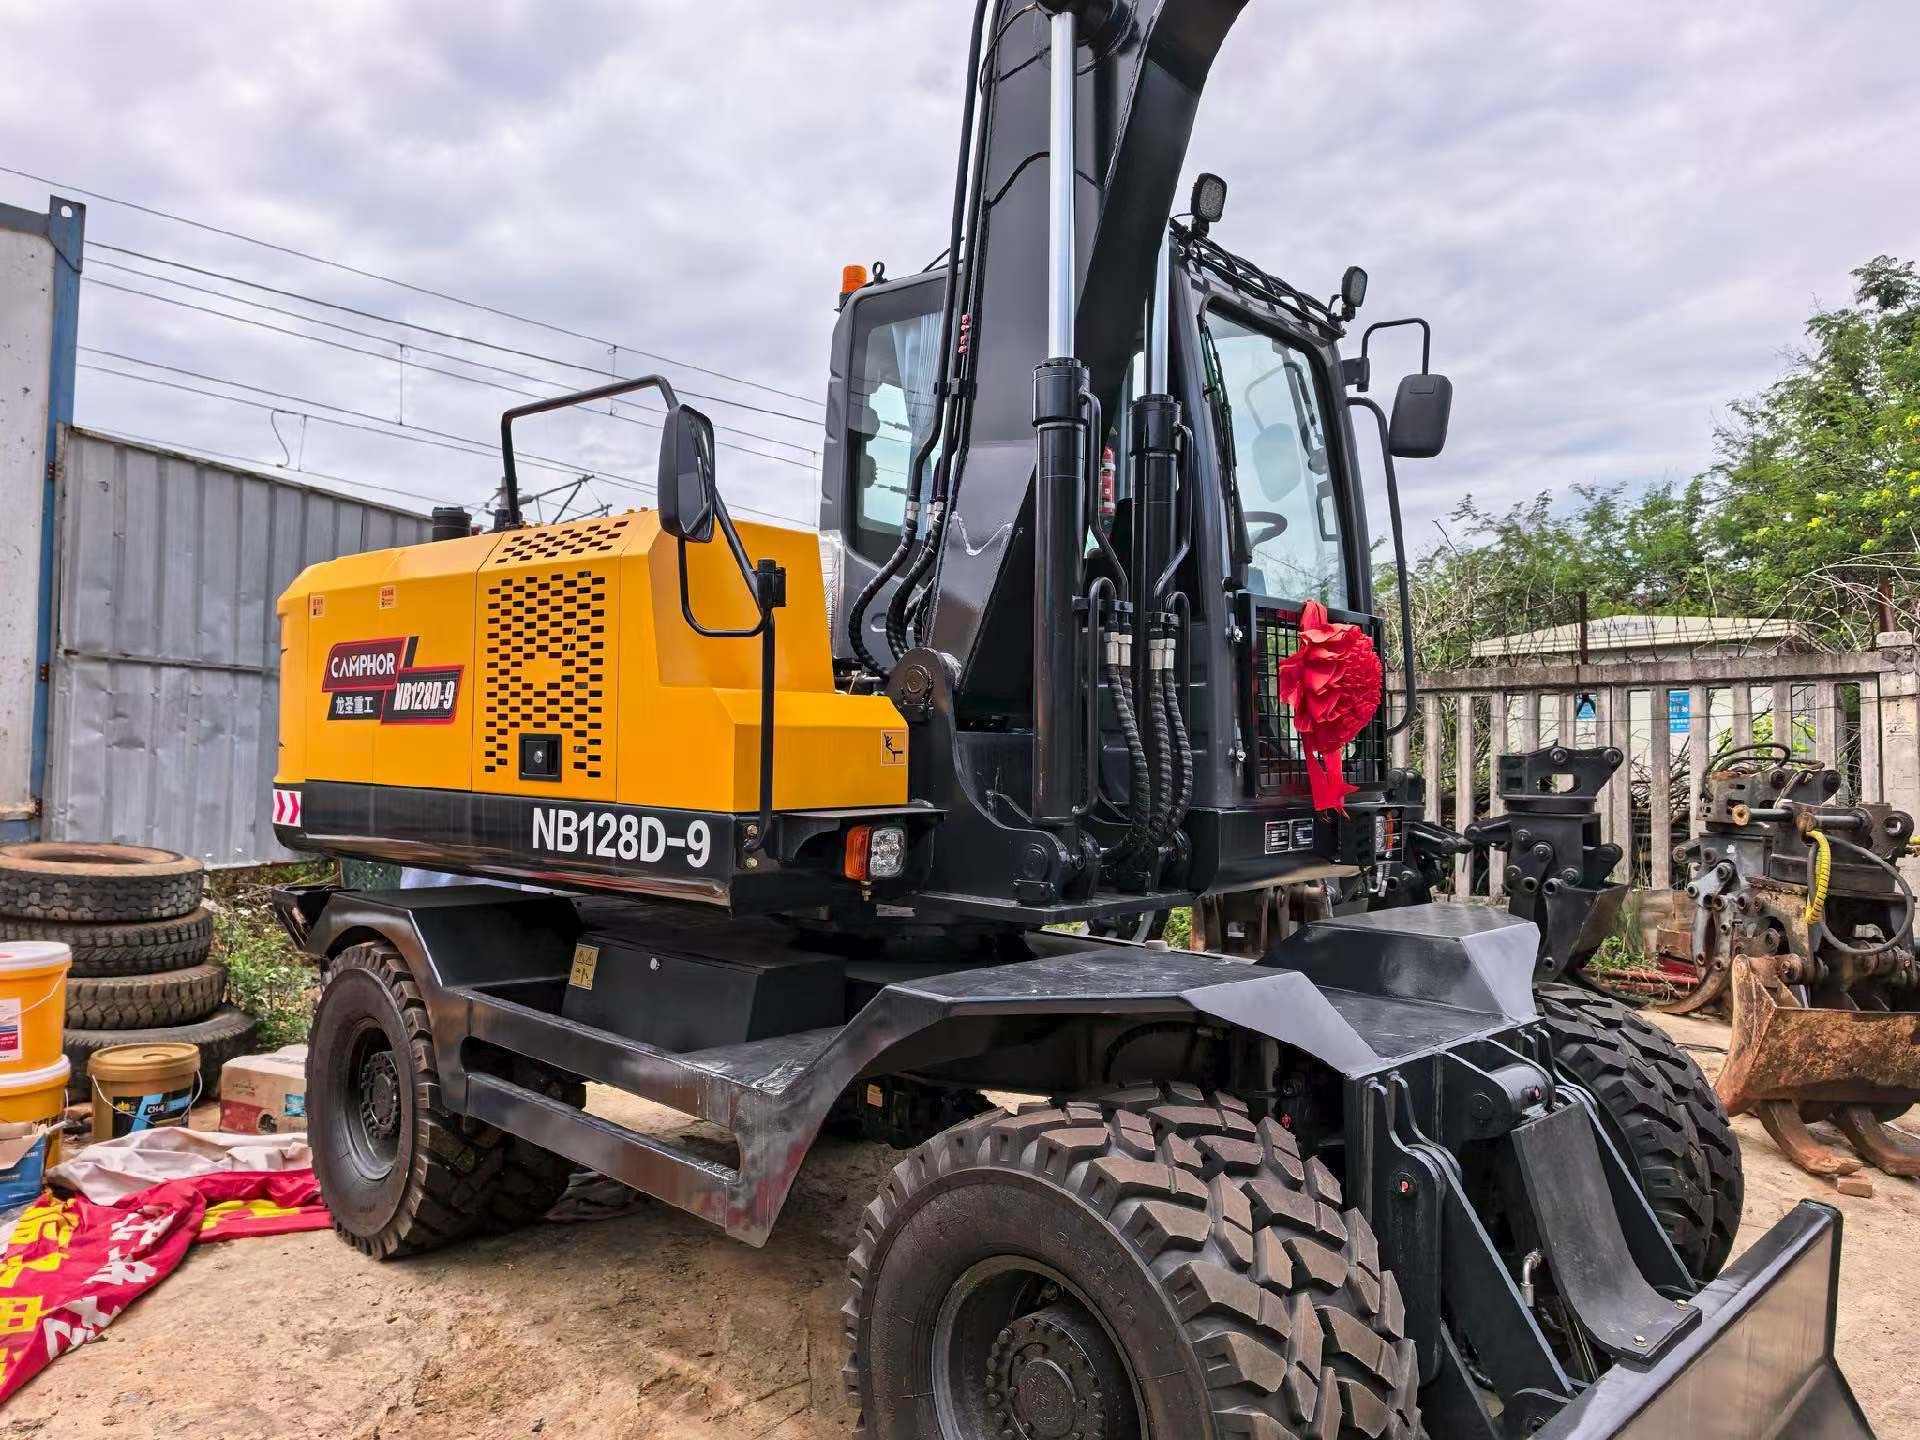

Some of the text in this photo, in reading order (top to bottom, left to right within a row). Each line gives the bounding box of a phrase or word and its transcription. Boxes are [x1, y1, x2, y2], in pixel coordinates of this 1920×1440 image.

[331, 652, 395, 678] CAMPHOR
[335, 696, 374, 714] 龙圣重工
[393, 681, 455, 711] NB128D-9
[532, 807, 711, 868] NB128D-9
